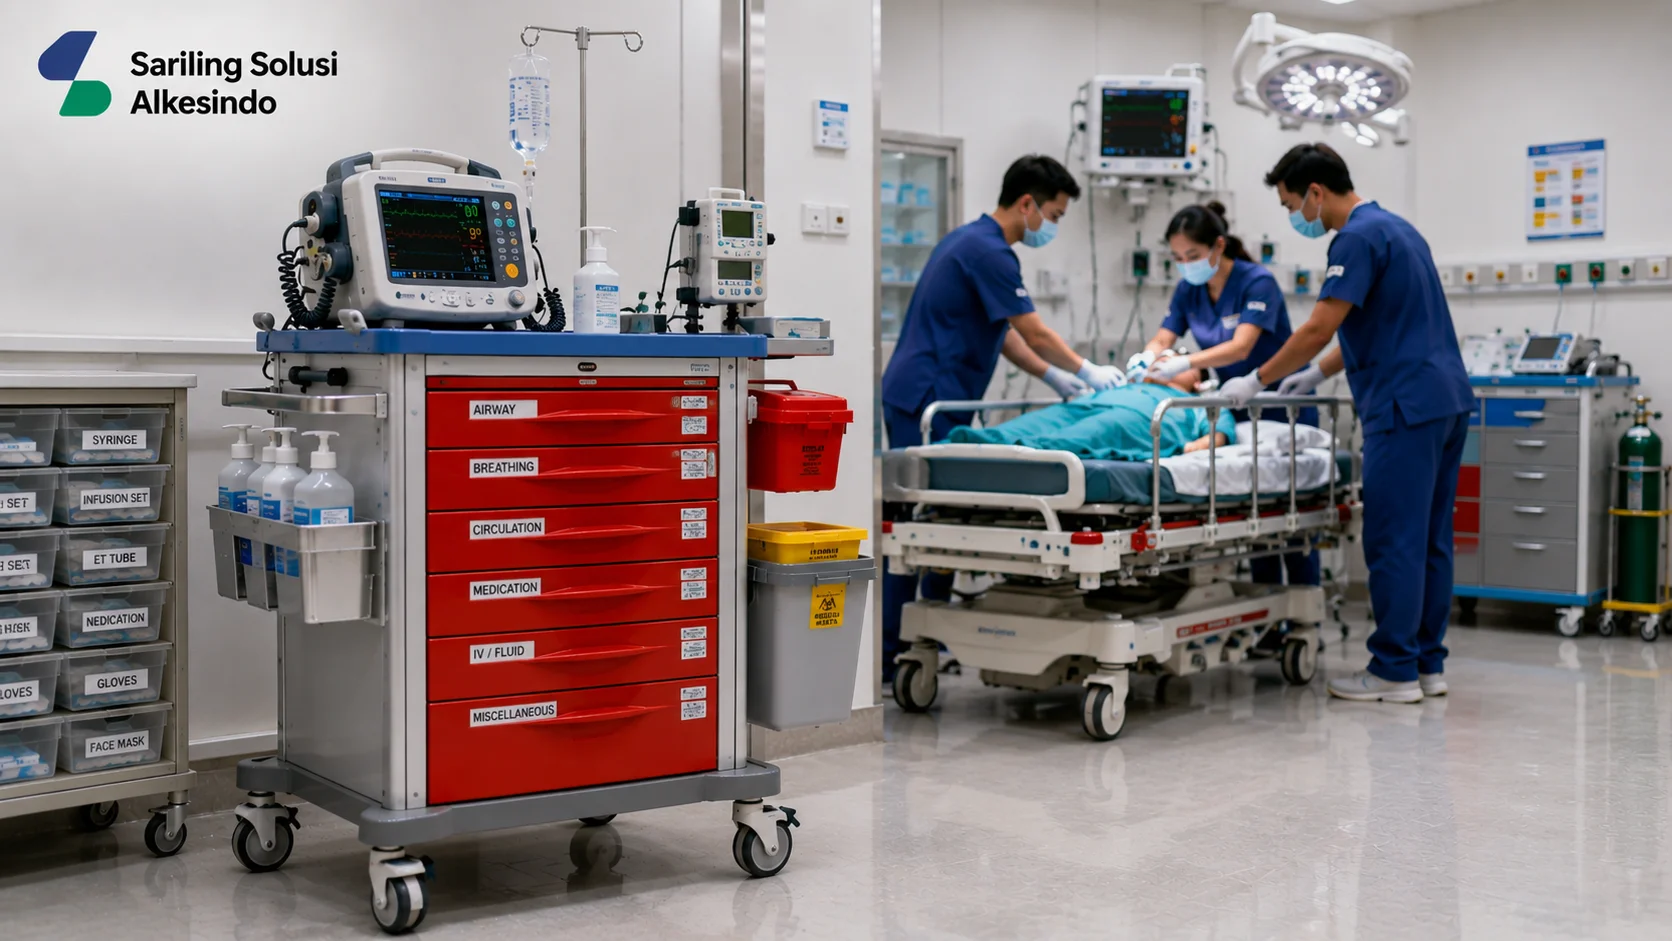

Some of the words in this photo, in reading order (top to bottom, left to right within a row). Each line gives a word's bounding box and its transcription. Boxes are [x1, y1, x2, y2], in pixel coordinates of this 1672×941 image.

[473, 404, 517, 415] AIRWAY
[92, 434, 138, 445] SYRINGE
[473, 461, 535, 474] BREATHING
[83, 493, 129, 505] INFUSION
[130, 492, 149, 503] SET
[472, 521, 542, 535] CIRCULATION
[94, 554, 107, 565] ET
[109, 552, 136, 564] TUBE
[472, 582, 538, 596] MEDICATION
[86, 612, 145, 628] NEDICATION
[473, 649, 484, 659] IV
[494, 645, 525, 658] FLUID
[97, 674, 138, 689] GLOVES
[472, 704, 555, 723] MISCELLANEOUS
[90, 740, 115, 753] FACE
[117, 736, 145, 749] MASK
